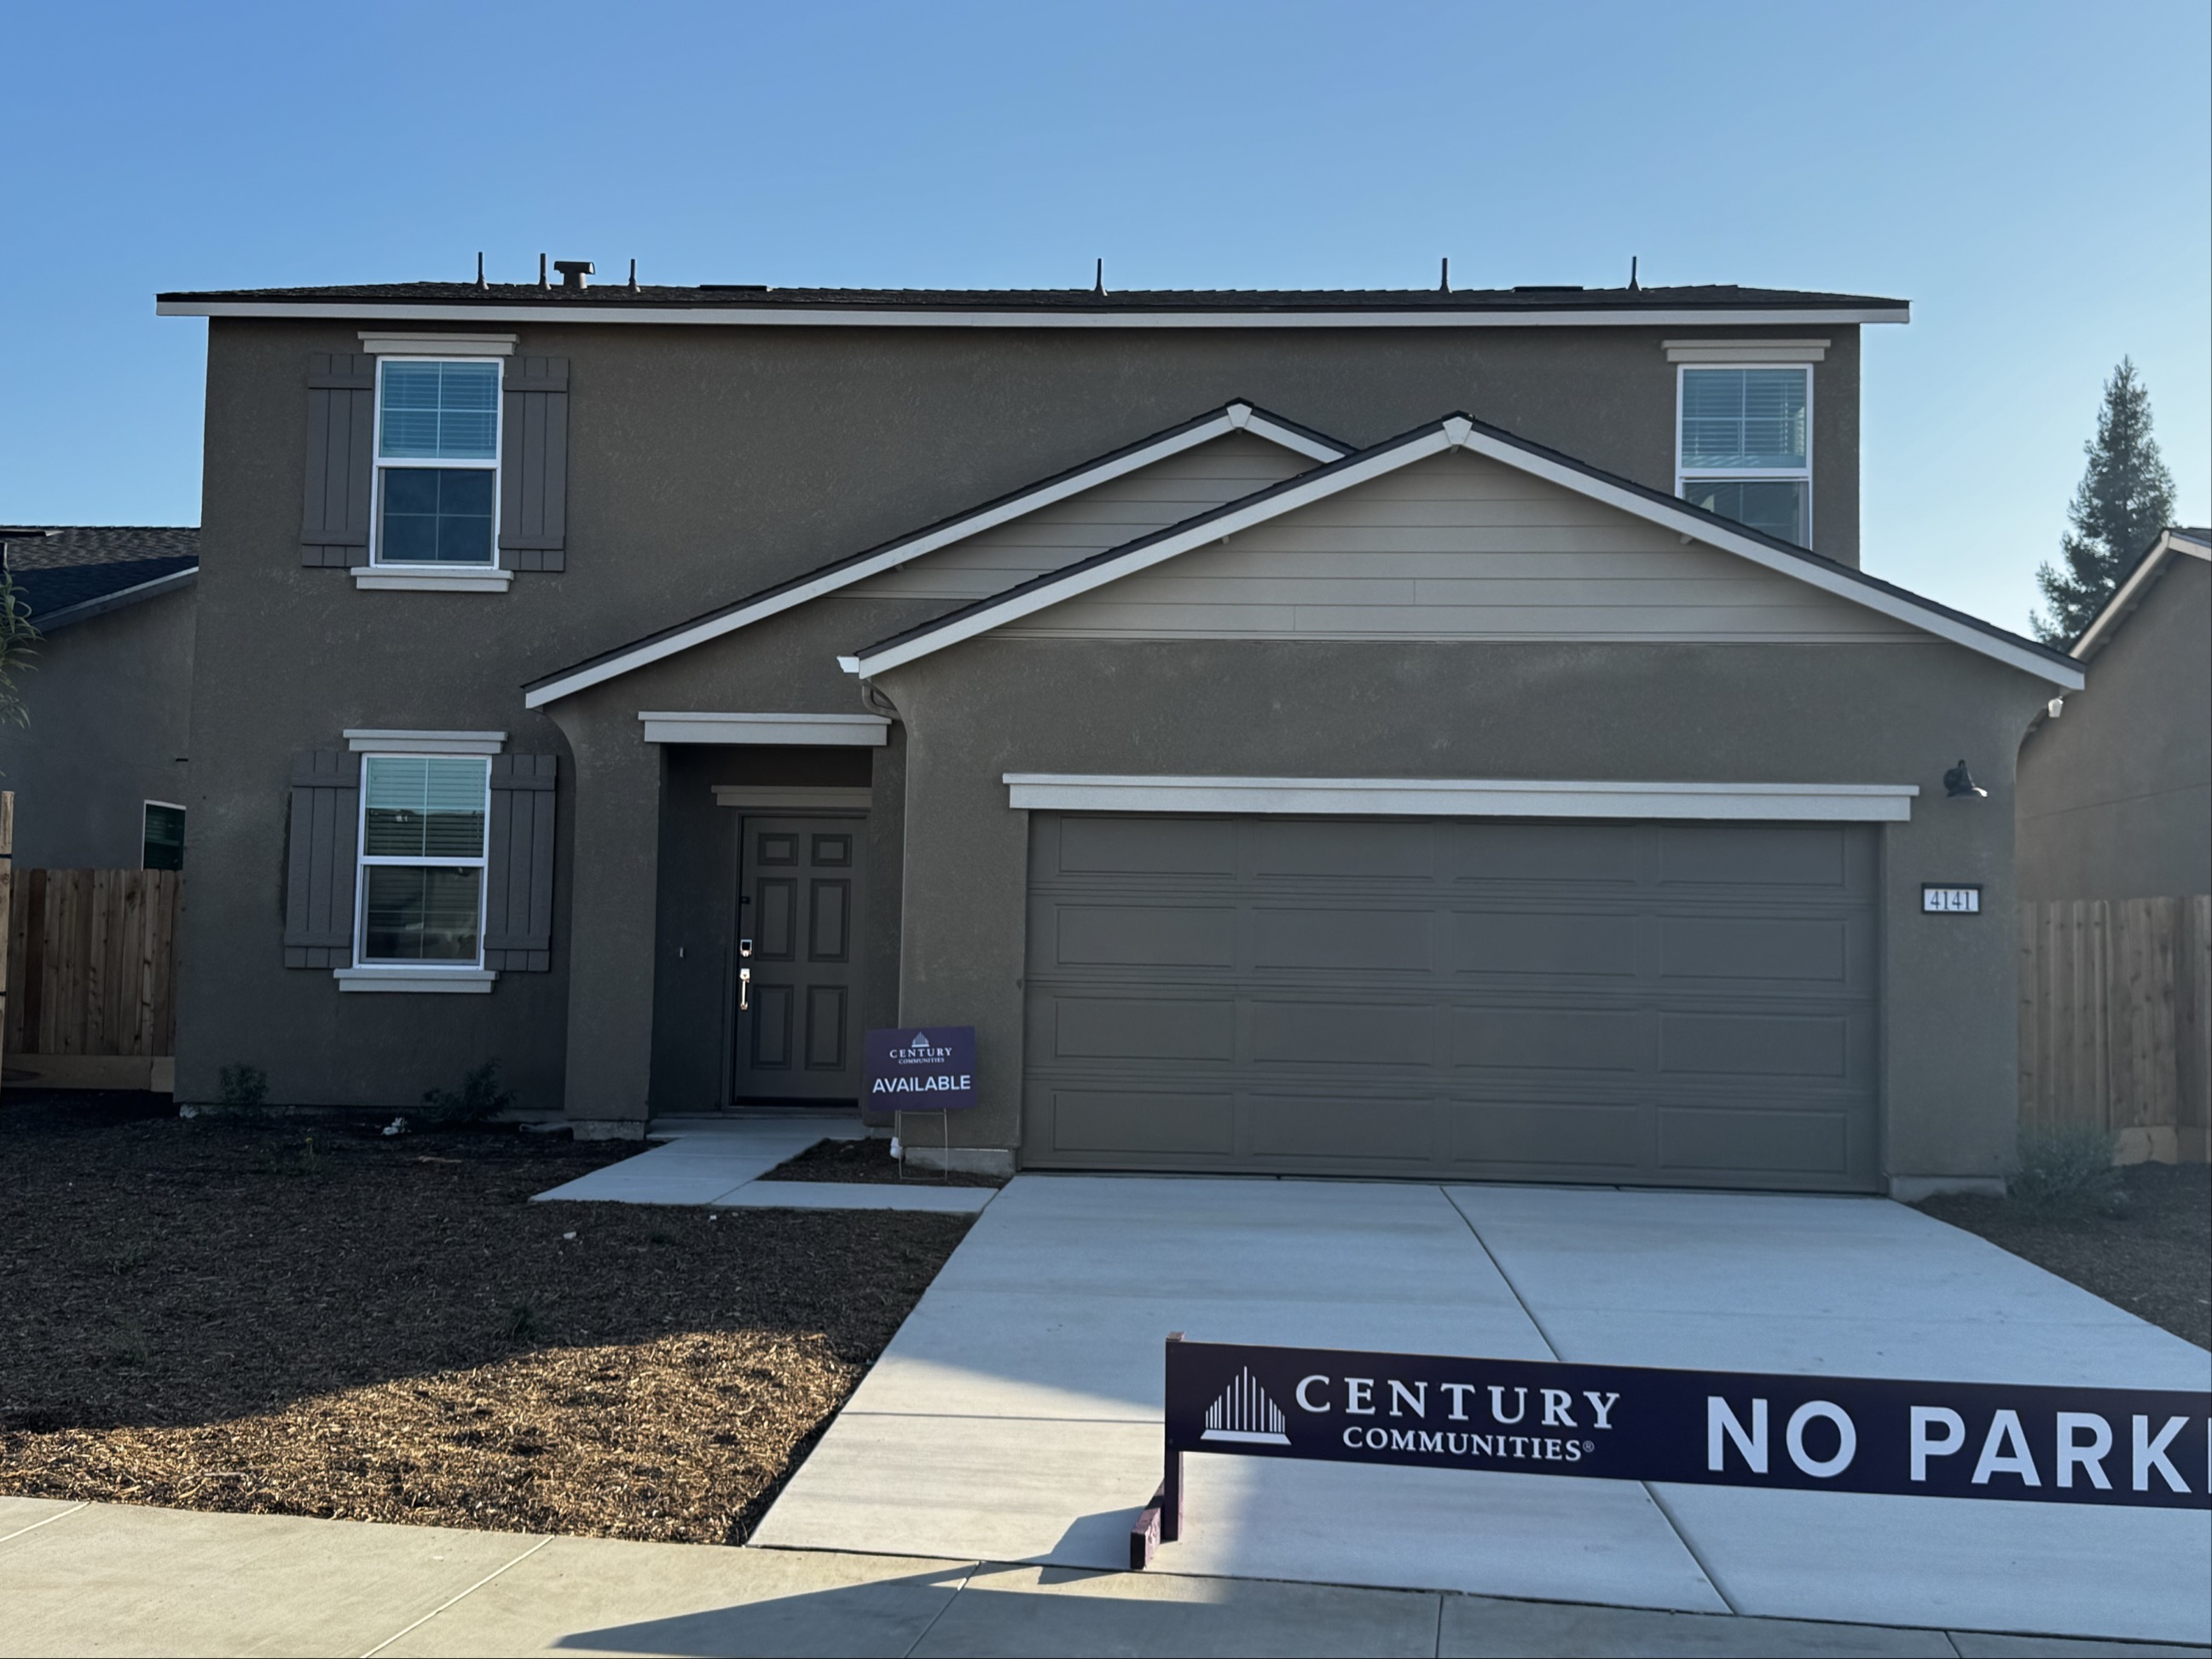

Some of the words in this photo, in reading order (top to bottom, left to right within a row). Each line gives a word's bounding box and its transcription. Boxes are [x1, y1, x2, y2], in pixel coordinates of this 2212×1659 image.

[1930, 890, 1971, 910] 4141
[889, 1048, 953, 1059] CENTURY
[872, 1075, 971, 1094] AVAILABLE
[1295, 1374, 1620, 1430] CENTURY
[1707, 1396, 1857, 1478] NO
[1909, 1405, 2212, 1494] PARK
